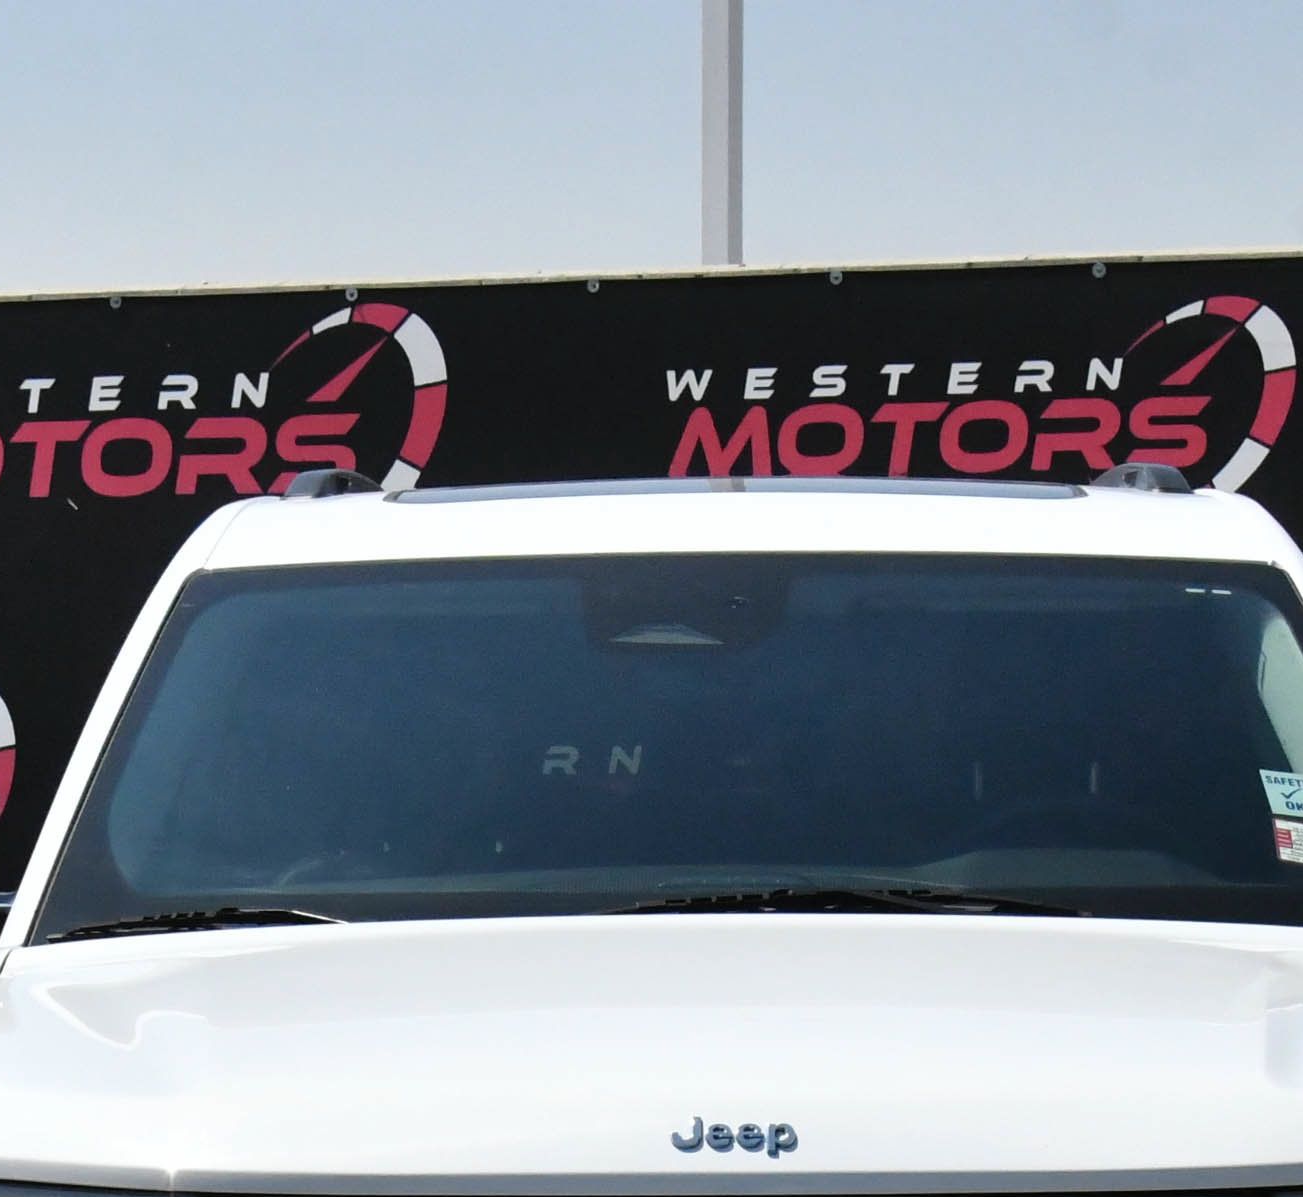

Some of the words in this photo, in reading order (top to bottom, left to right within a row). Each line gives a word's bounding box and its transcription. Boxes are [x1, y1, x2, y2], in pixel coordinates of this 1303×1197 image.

[667, 357, 1124, 402] WESTERN
[668, 395, 1212, 477] MOTORS
[671, 1115, 798, 1159] Jeep
